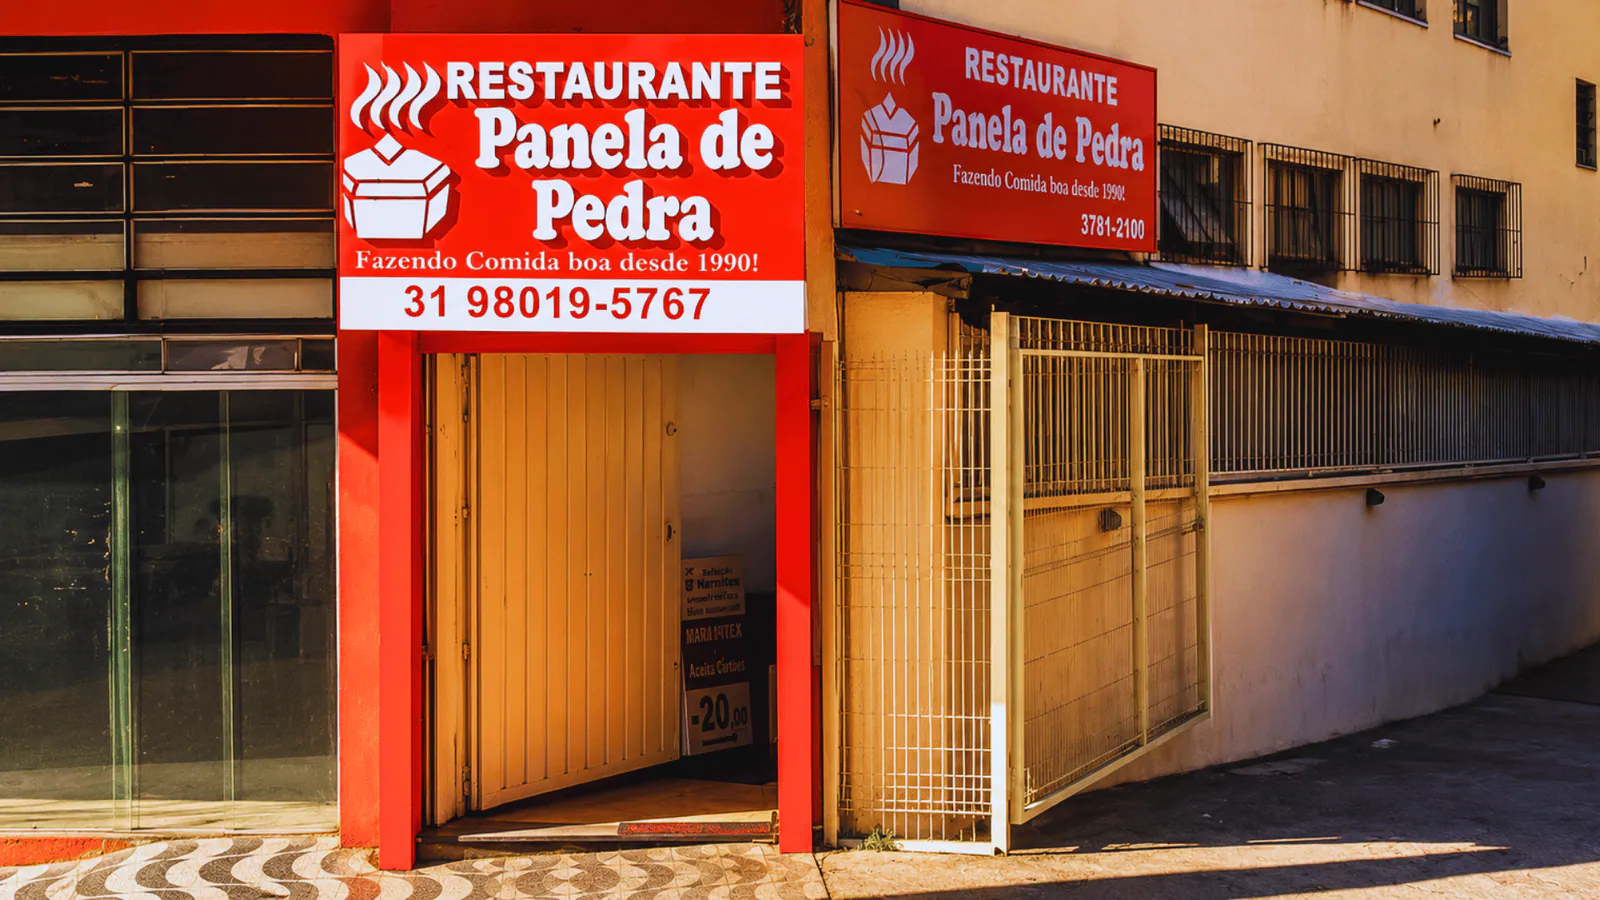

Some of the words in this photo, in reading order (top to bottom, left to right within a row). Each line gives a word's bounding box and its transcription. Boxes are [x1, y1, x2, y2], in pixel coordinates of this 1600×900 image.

[447, 61, 781, 99] RESTAURANTE
[966, 47, 1117, 106] RESTAURANTE
[474, 107, 683, 169] Panela
[700, 108, 774, 170] de
[932, 92, 1027, 155] Panela
[1036, 112, 1066, 160] de
[1076, 116, 1144, 171] Pedra
[953, 163, 1001, 188] Fazendo
[1005, 171, 1047, 193] Comida
[1050, 176, 1069, 195] boa
[1072, 180, 1099, 199] desde
[1102, 184, 1126, 201] 1990!
[532, 179, 714, 241] Pedra
[1081, 213, 1145, 239] 3781-2100
[355, 250, 457, 270] Fazendo
[466, 251, 559, 271] Comida
[568, 252, 611, 271] boa
[620, 252, 689, 272] desde
[699, 253, 759, 273] 1990!
[404, 285, 446, 317] 31
[467, 286, 710, 319] 98019-5767
